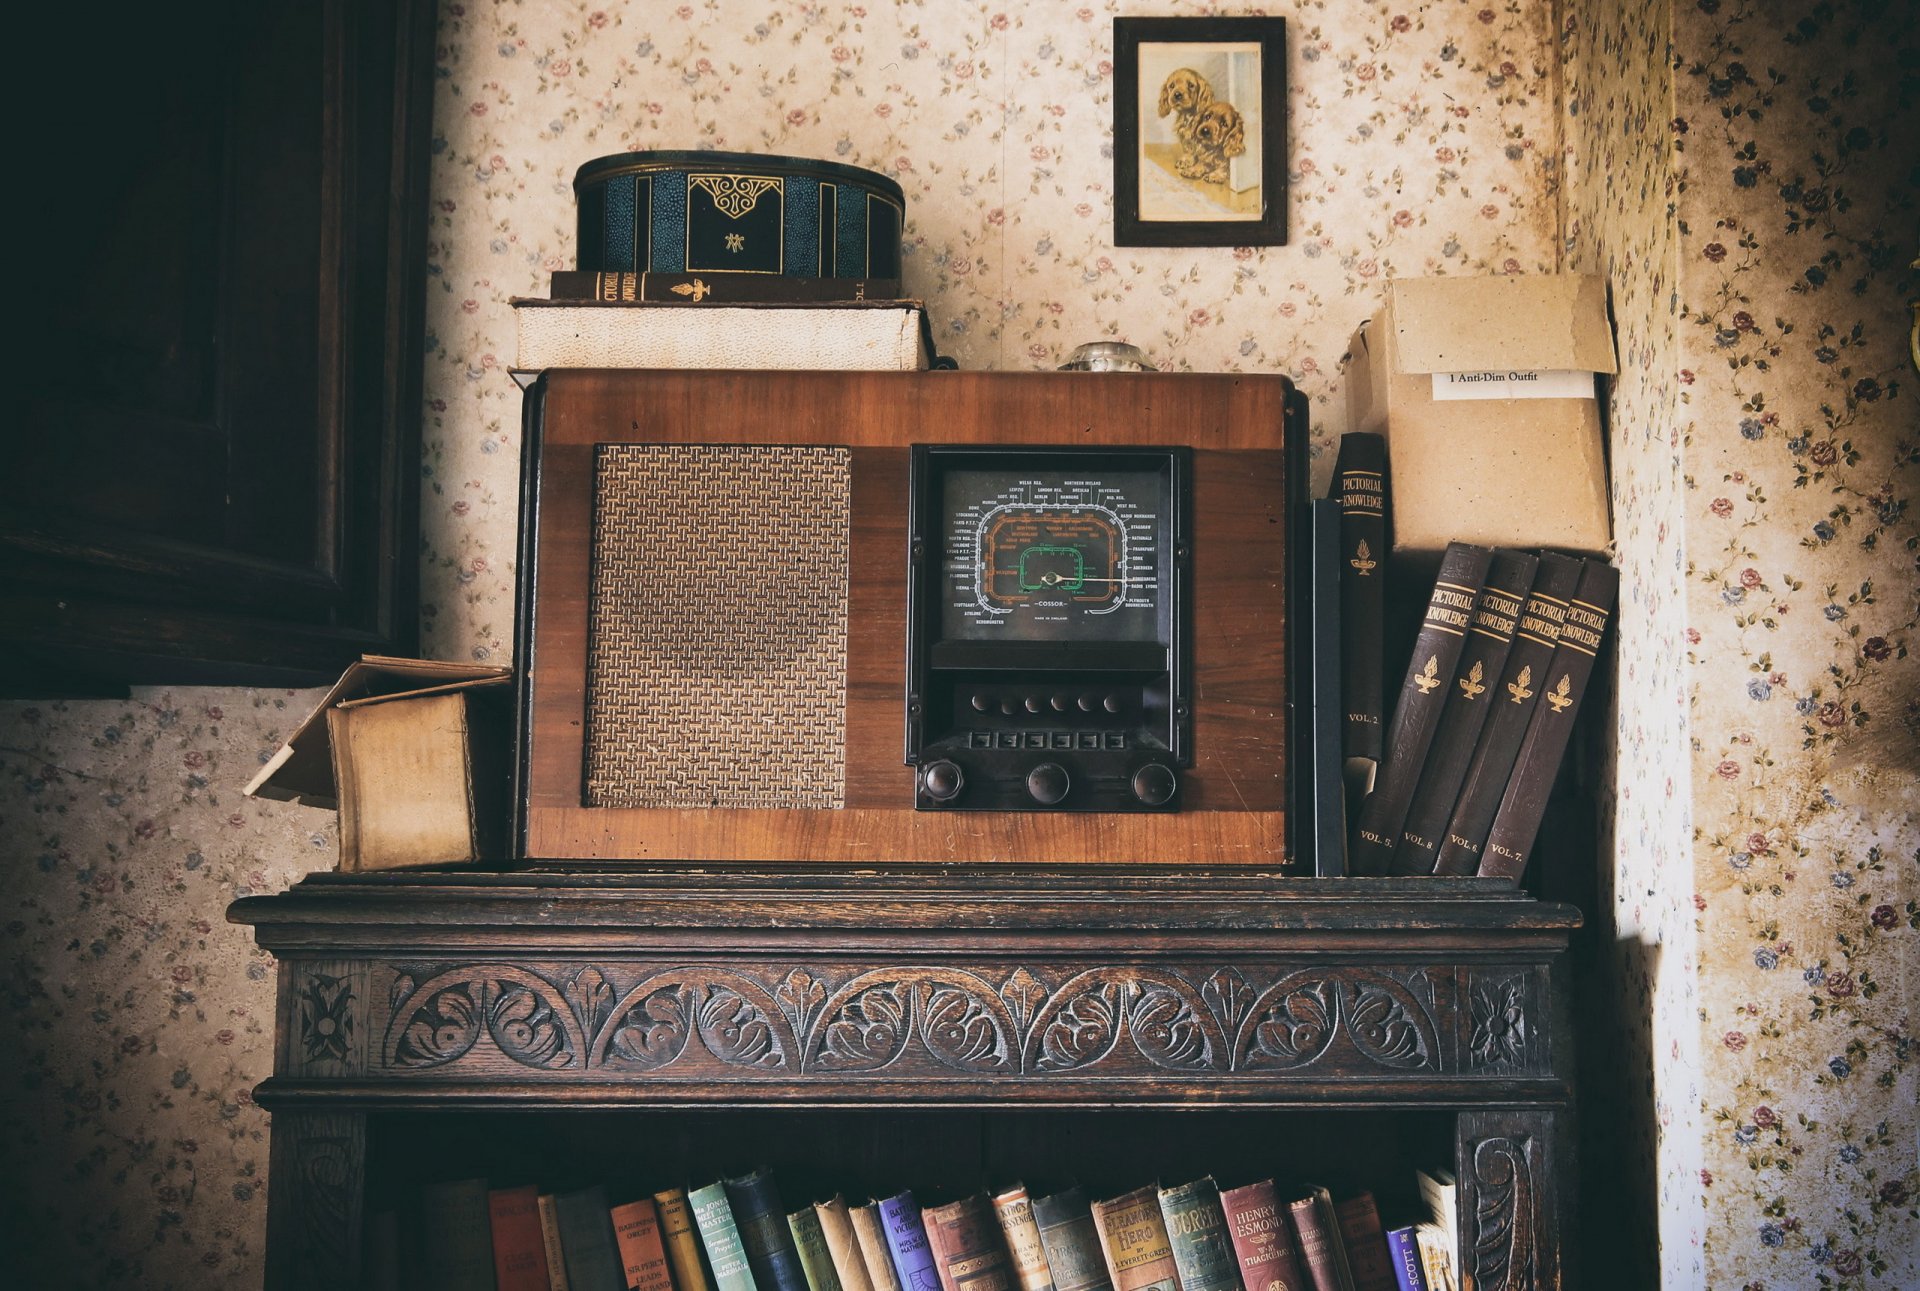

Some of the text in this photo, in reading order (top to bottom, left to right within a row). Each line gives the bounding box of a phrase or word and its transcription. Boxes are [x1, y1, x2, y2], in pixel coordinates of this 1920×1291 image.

[604, 272, 619, 301] CTORIAL
[1458, 372, 1505, 383] Anti-Dim
[1508, 372, 1538, 382] Outfit
[1343, 478, 1383, 492] PICTORIAL
[1343, 494, 1383, 510] KNOWLEDGE
[1430, 588, 1472, 610] PICTORIAL
[1480, 593, 1520, 618] PICTORIAL
[1426, 606, 1469, 628] KNOWLEDGE
[1526, 598, 1566, 623] PICTORIAL
[1566, 606, 1606, 632] PICTORIAL
[1476, 610, 1516, 635] KNOWLEDGE
[1520, 616, 1562, 640] KNOWLEDGE
[1560, 622, 1602, 649] KNOWLEDGE
[1350, 714, 1372, 723] VOL.
[1361, 830, 1393, 848] VOL. 5.
[1405, 832, 1426, 846] VOL.
[1451, 834, 1470, 850] VOL.
[1492, 844, 1522, 862] VOL. 7.
[706, 1197, 728, 1210] JONES
[1000, 1202, 1027, 1218] KING'S
[696, 1206, 731, 1222] MEET THE
[1236, 1204, 1276, 1224] HENRY
[618, 1218, 656, 1232] BARONESS
[627, 1228, 651, 1240] ORCZY
[1236, 1216, 1283, 1238] ESMOND
[1117, 1226, 1154, 1251] HERO
[1013, 1242, 1039, 1256] FRANK
[628, 1258, 664, 1275] SIR PERCY
[1403, 1248, 1420, 1286] SCOTT
[636, 1272, 662, 1284] LEADS
